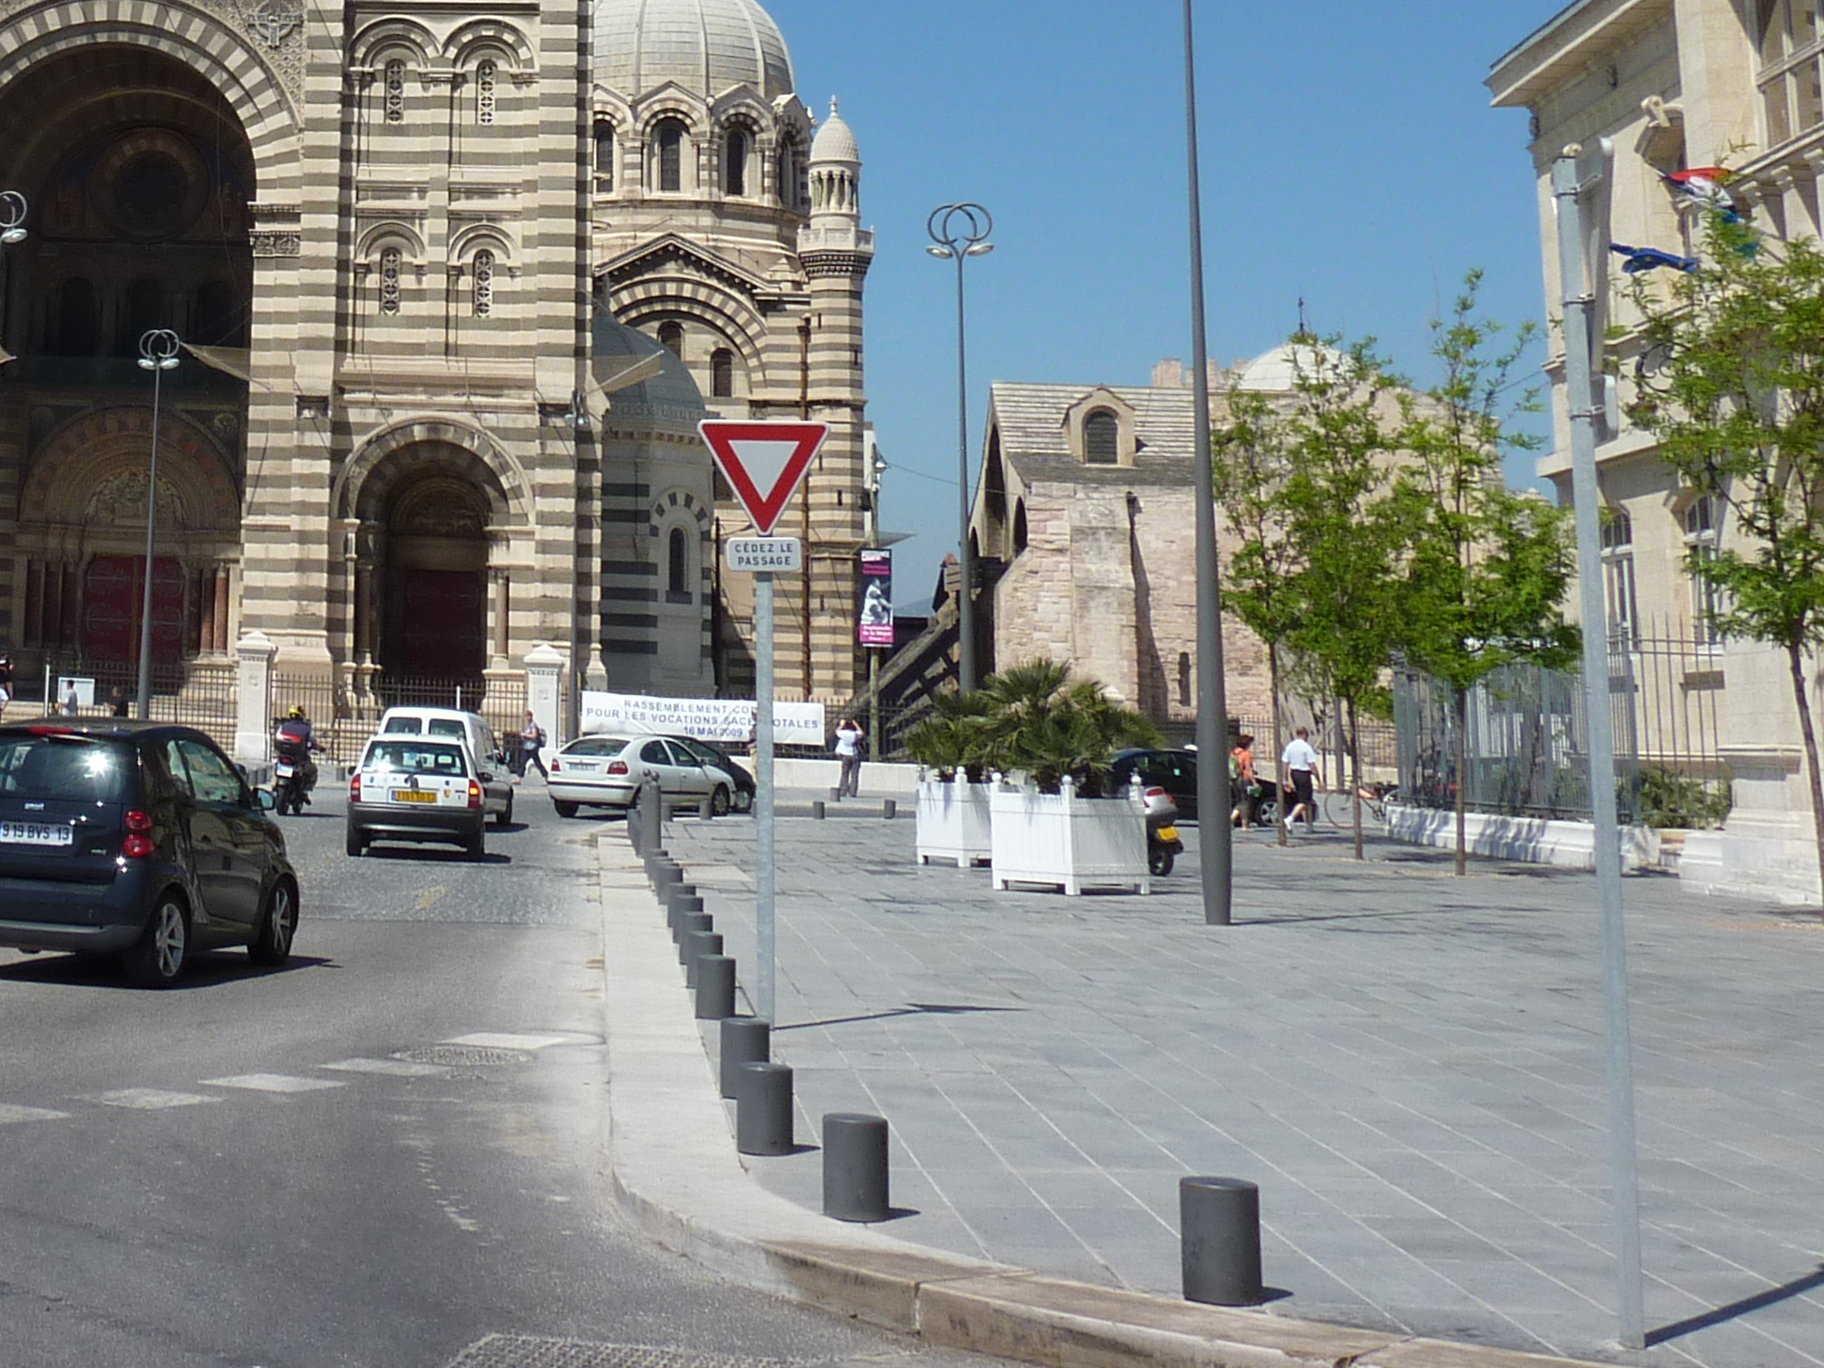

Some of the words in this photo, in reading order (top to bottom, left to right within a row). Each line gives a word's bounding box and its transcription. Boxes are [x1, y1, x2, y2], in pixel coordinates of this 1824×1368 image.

[735, 541, 774, 553] CÉDEZ
[780, 543, 793, 553] LE
[738, 556, 791, 566] PASSAGE
[624, 699, 727, 714] RASSEMBLEMENT
[587, 707, 620, 719] POUR
[625, 711, 646, 721] LES
[651, 713, 718, 725] VOCATIONS
[684, 726, 695, 736] 16
[697, 727, 717, 736] MAI
[720, 728, 743, 737] 2009
[27, 825, 51, 840] BVS
[57, 827, 70, 841] 13
